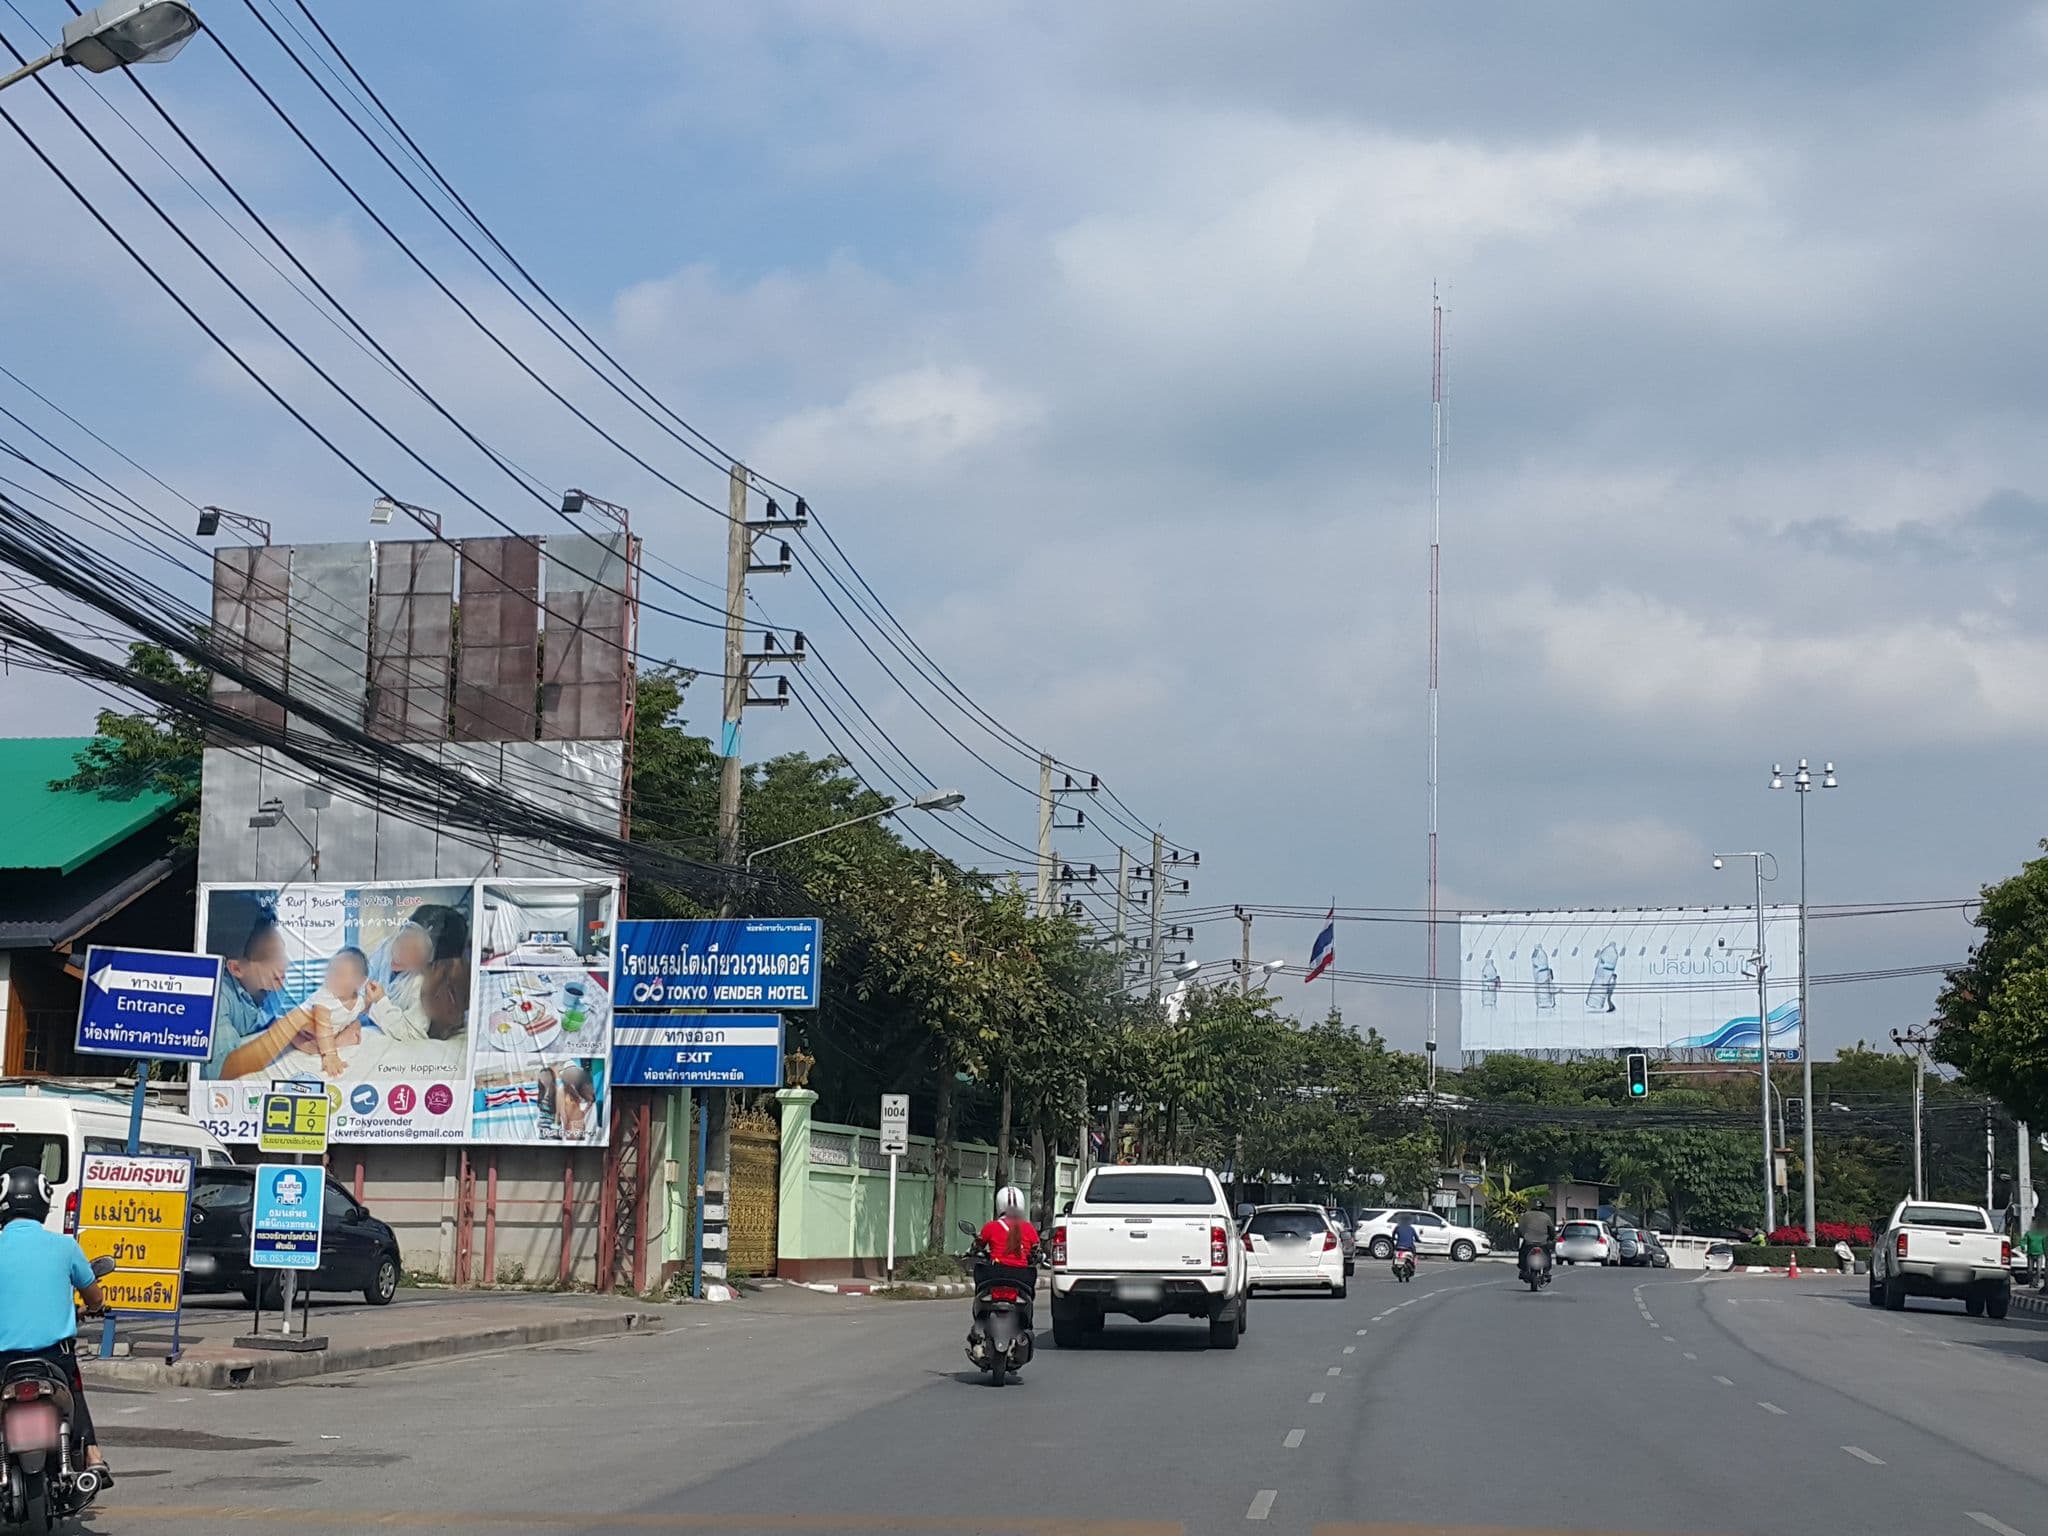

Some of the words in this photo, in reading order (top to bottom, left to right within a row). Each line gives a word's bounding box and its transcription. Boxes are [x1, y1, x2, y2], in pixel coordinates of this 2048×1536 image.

[259, 895, 281, 908] We
[287, 896, 308, 907] Run
[312, 895, 360, 907] Business
[620, 943, 811, 976] โรงแรมโตเกียวเวนเดอร์
[131, 976, 182, 992] ทางเข้า
[666, 985, 708, 1000] TOKYO
[713, 985, 763, 1000] VENDER
[768, 985, 809, 1000] HOTEL
[117, 996, 186, 1015] Entrance
[84, 1021, 209, 1048] ห้องพักราคาประหยัด
[664, 1029, 726, 1044] ทางออก
[676, 1051, 713, 1063] EXIT
[378, 1064, 407, 1074] Family
[410, 1064, 458, 1075] Happiness
[643, 1067, 745, 1081] ห้องพักราคาประหยัด
[308, 1101, 317, 1114] 2
[884, 1106, 905, 1117] 1004
[306, 1118, 316, 1131] 9
[349, 1117, 413, 1128] Tokyovender
[87, 1161, 185, 1186] รับสมัครงาน
[94, 1199, 162, 1223] แม่บ้าน
